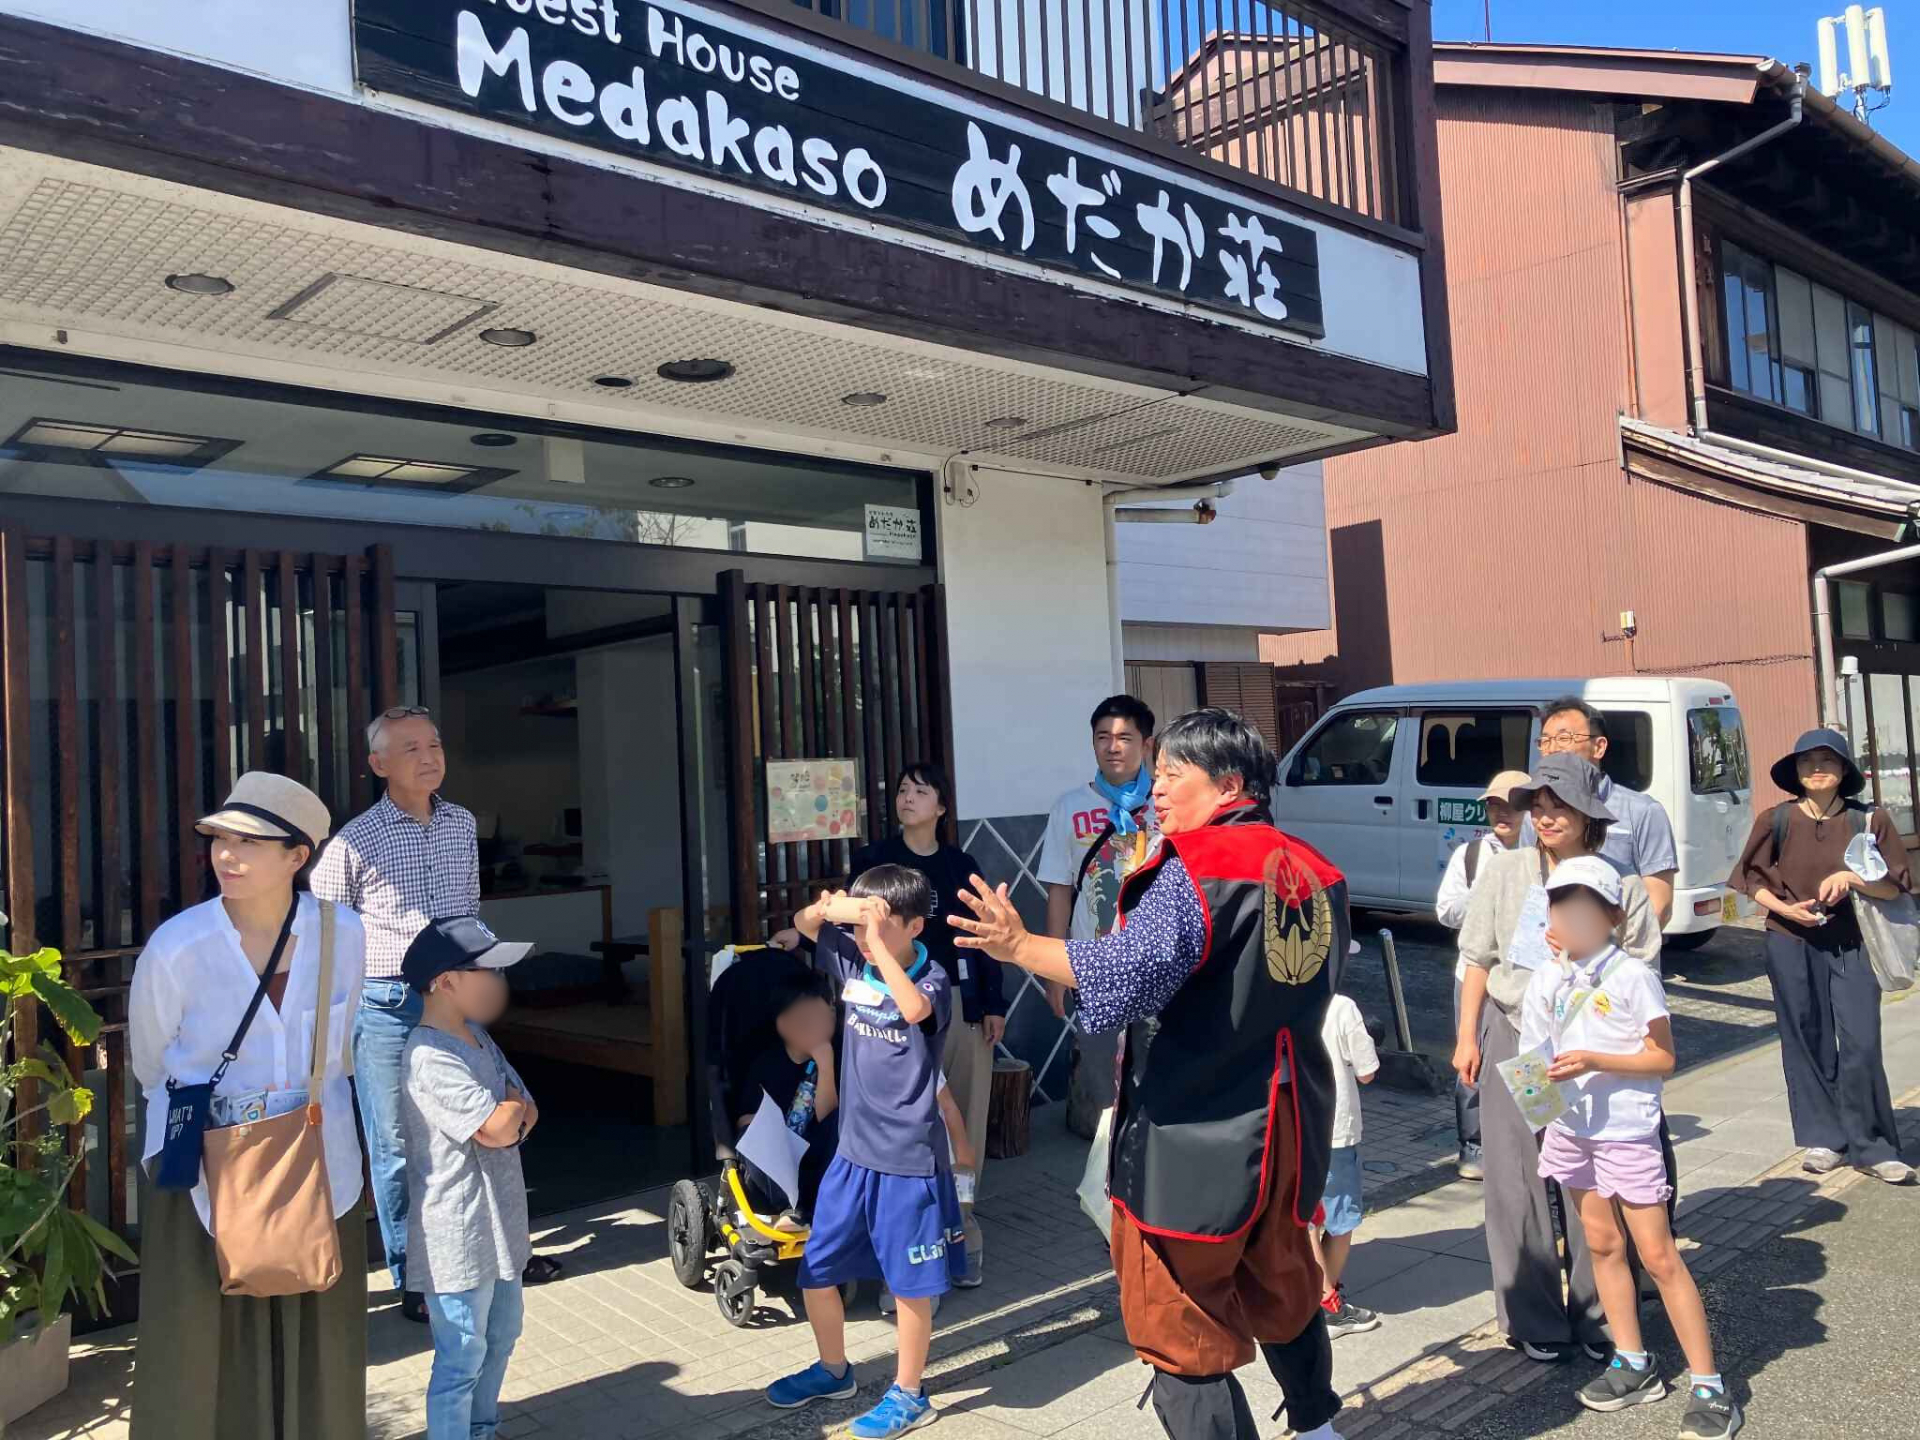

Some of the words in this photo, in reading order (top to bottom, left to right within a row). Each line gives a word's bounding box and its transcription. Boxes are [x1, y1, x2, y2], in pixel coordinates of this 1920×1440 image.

[456, 10, 888, 209] Medakaso
[483, 0, 622, 43] est
[648, 6, 800, 101] House
[951, 120, 1288, 321] めだか荘
